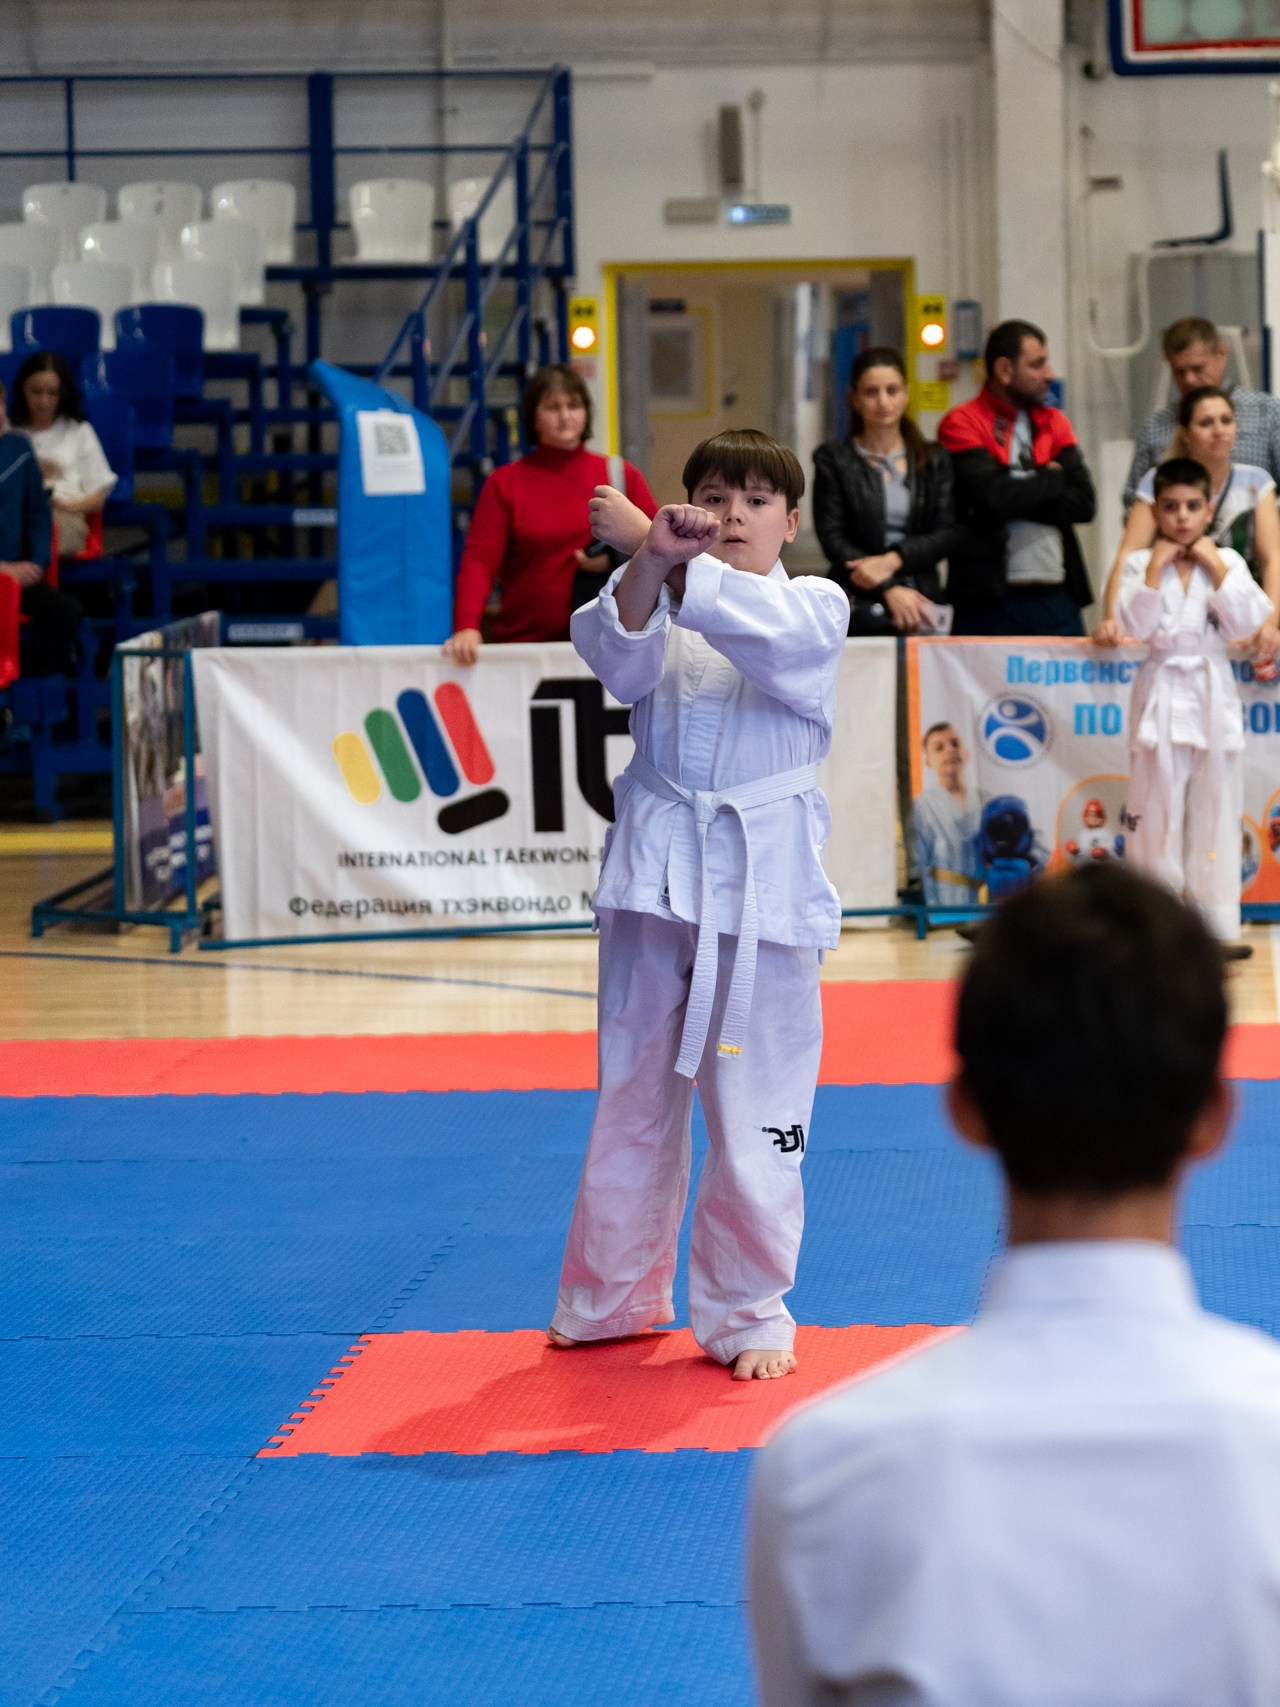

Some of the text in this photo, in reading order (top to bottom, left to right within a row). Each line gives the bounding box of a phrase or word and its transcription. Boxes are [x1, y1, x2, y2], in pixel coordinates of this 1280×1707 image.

[1007, 654, 1142, 686] Первенс
[338, 846, 605, 868] INTERNATIONAL TAEKWON-
[288, 896, 433, 919] Федерация
[441, 895, 571, 914] тхэквондо
